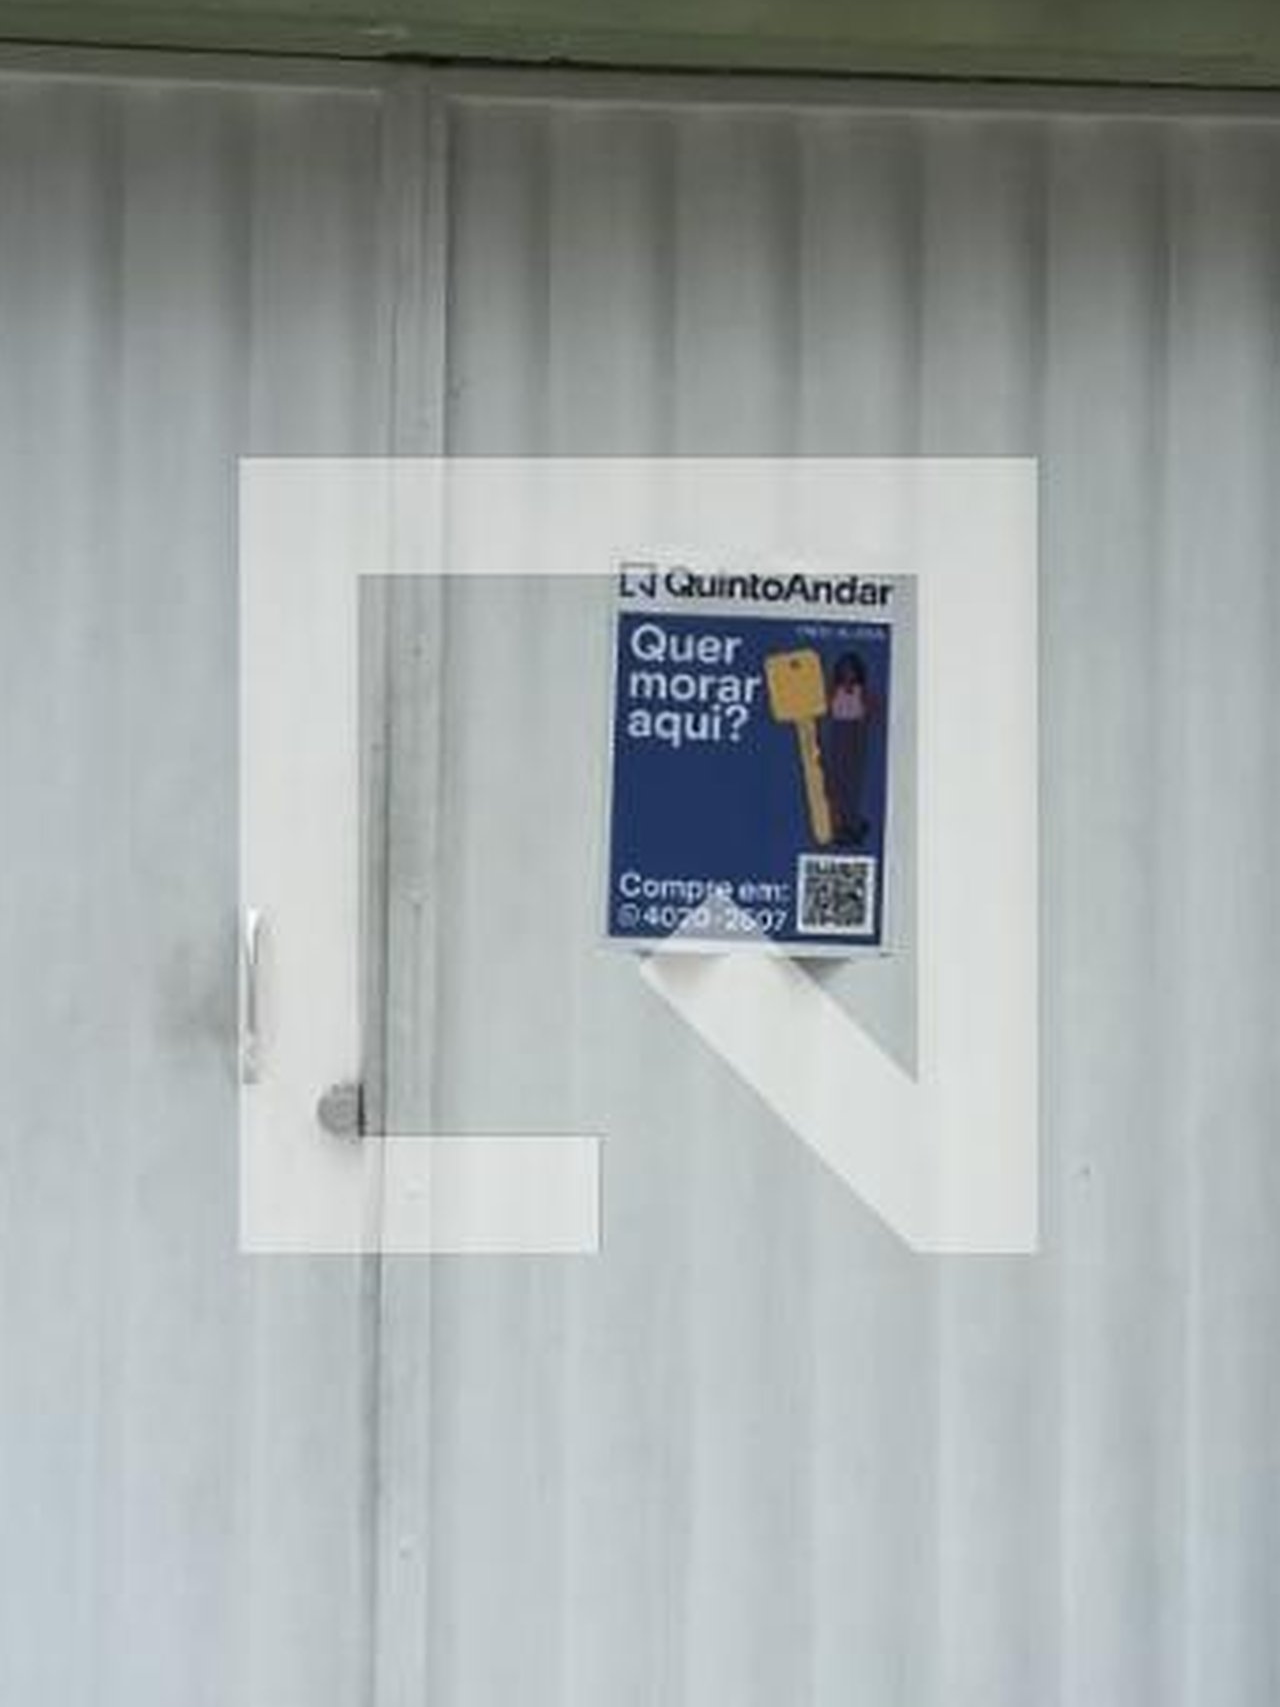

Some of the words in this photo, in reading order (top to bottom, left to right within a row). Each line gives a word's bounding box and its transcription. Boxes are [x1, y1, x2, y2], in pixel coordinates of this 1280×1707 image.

[664, 566, 894, 606] QuintoAndar
[630, 622, 742, 665] Quer
[629, 671, 761, 704] morar
[627, 703, 749, 749] aqui?
[619, 871, 734, 903] Compre
[738, 882, 791, 903] em:
